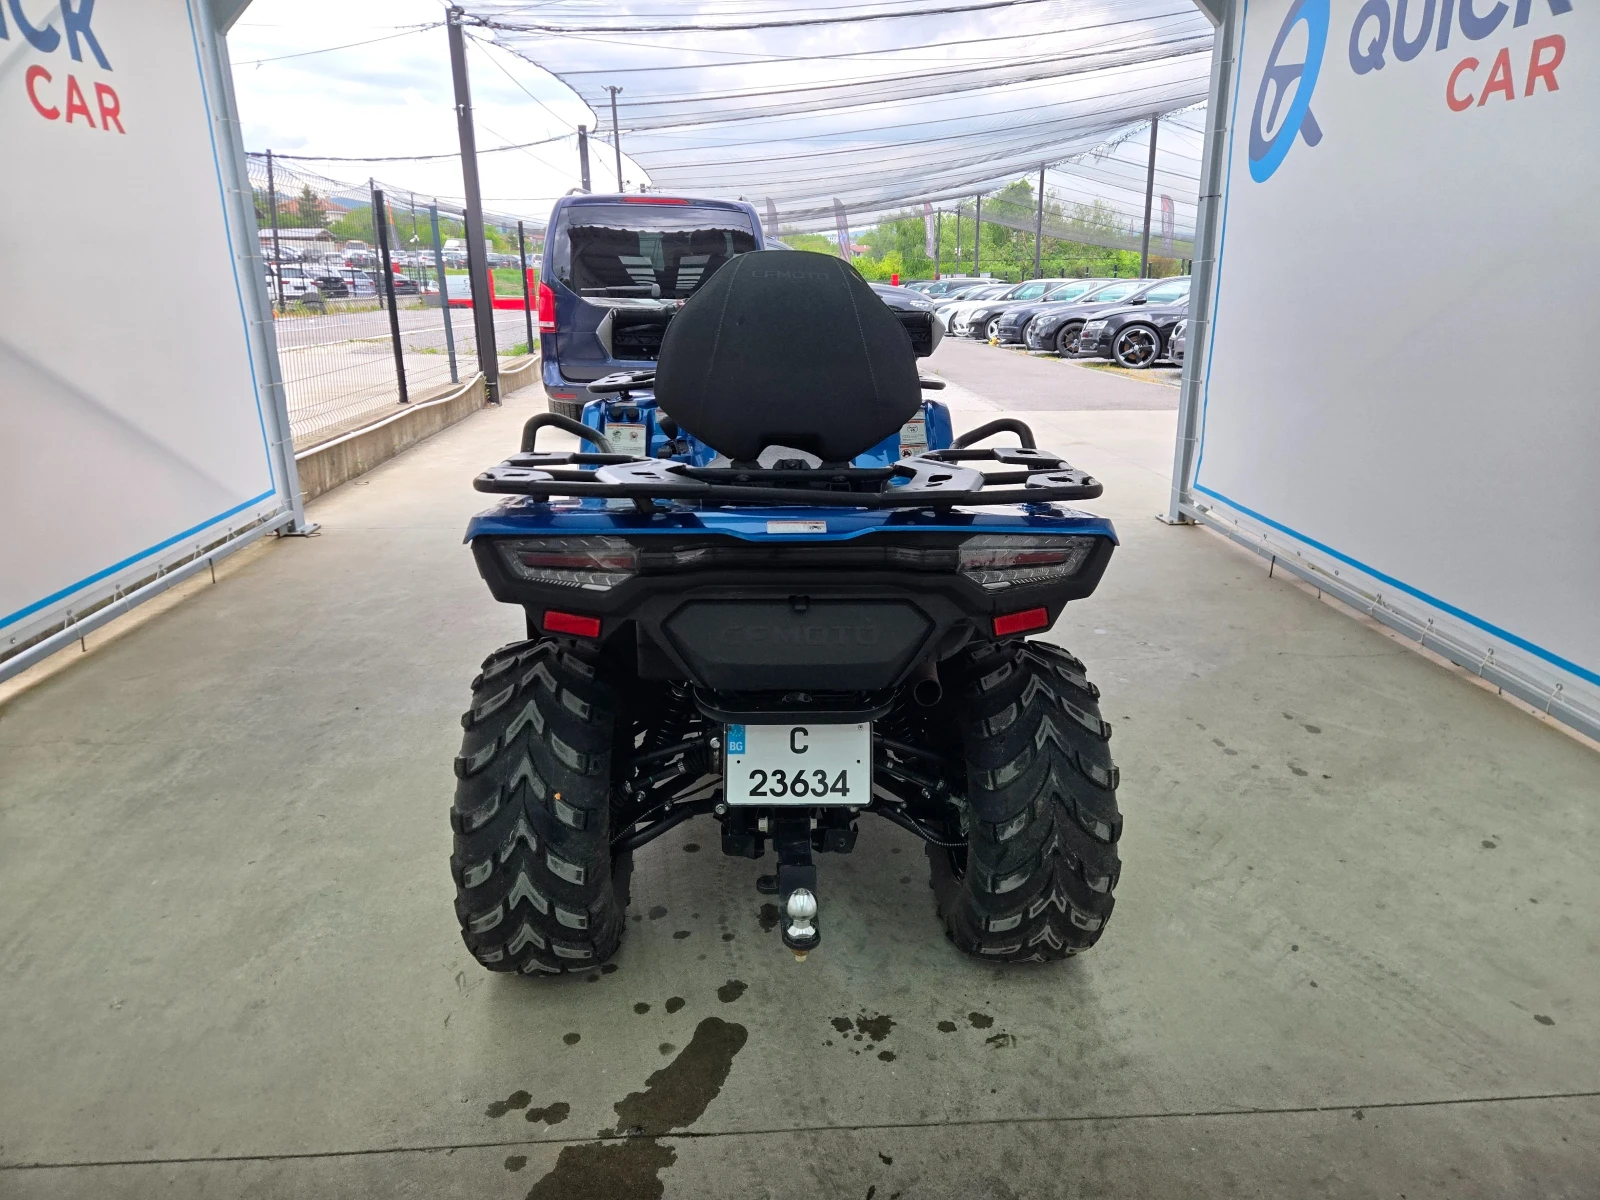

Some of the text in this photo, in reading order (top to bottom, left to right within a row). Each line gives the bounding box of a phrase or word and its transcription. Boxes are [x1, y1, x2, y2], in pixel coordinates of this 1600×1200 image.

[0, 0, 113, 72] CK
[1446, 34, 1566, 112] CAR
[25, 64, 126, 135] CAR
[729, 741, 743, 751] BG
[789, 726, 809, 754] C
[749, 769, 850, 798] 23634
